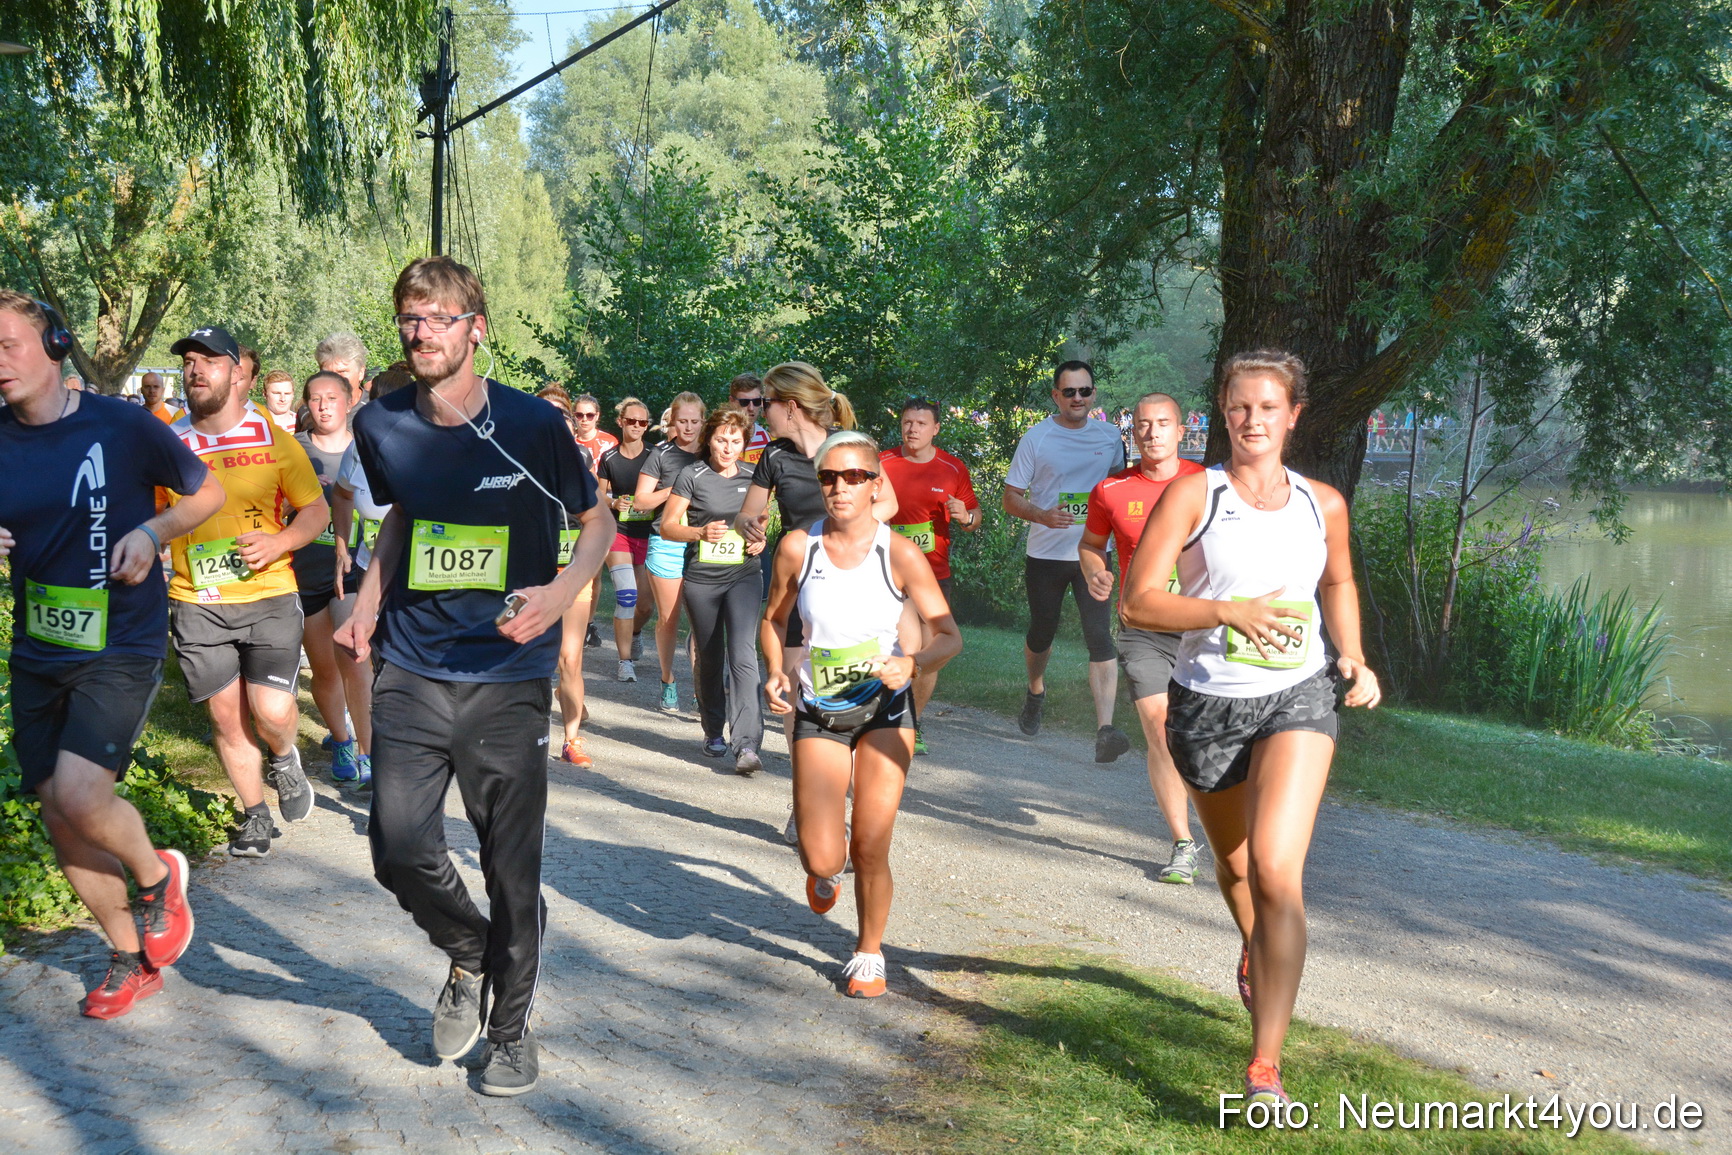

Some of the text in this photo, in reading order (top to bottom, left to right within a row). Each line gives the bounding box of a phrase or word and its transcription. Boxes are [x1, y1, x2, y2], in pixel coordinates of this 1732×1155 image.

[222, 452, 277, 469] BÖGL
[424, 546, 494, 571] 1087
[710, 542, 736, 554] 752
[196, 552, 243, 576] 1246
[33, 604, 94, 632] 1597
[820, 661, 873, 685] 1552
